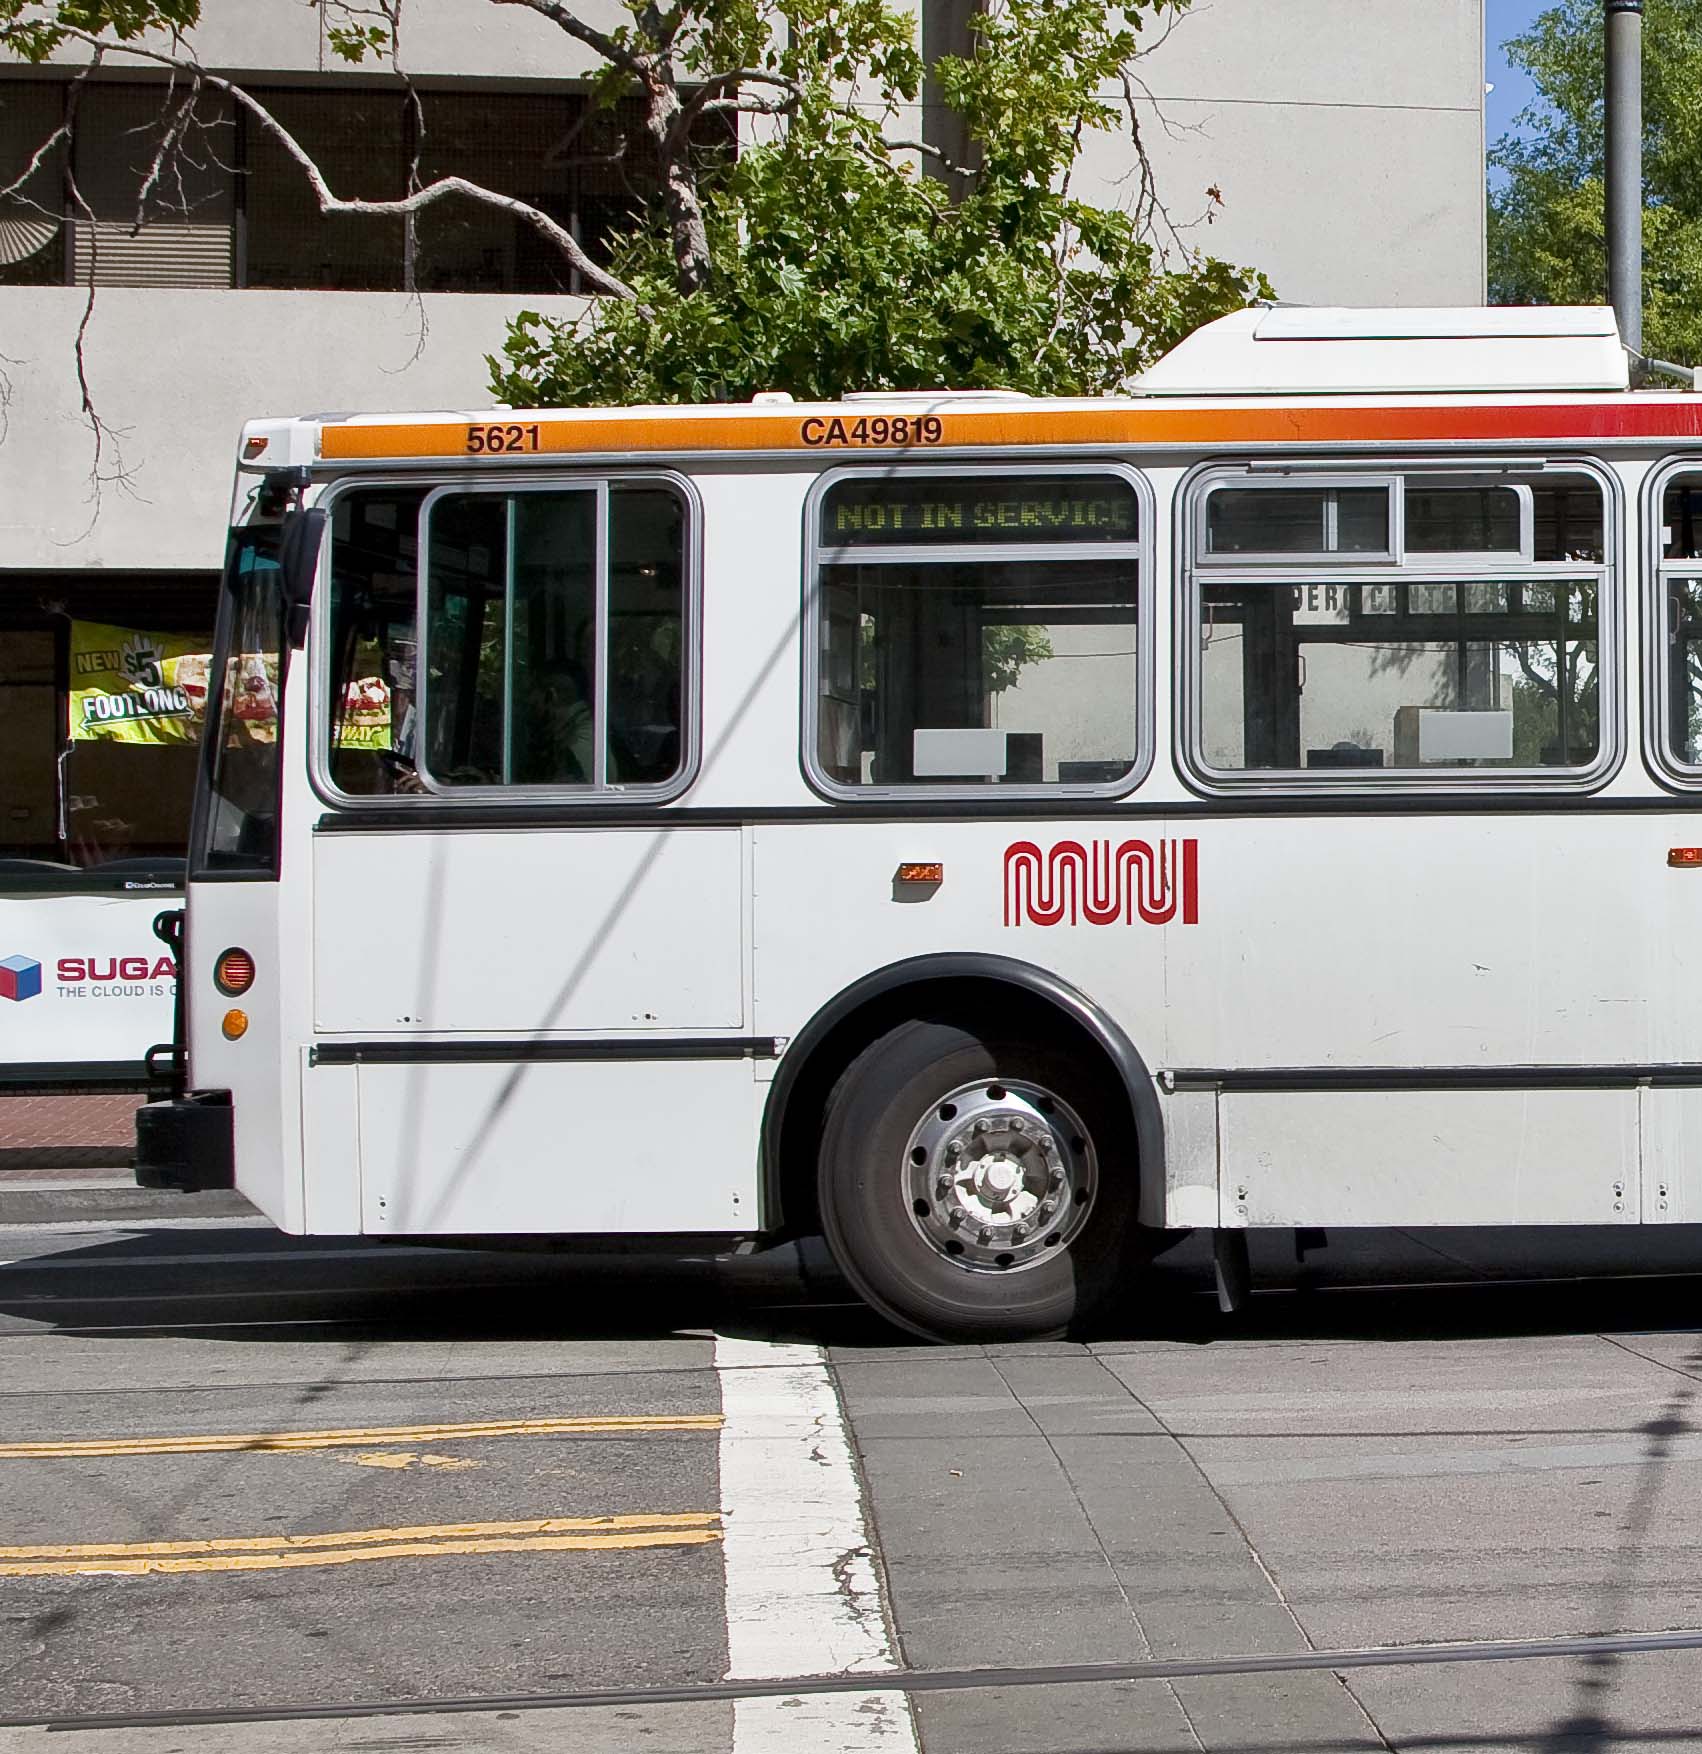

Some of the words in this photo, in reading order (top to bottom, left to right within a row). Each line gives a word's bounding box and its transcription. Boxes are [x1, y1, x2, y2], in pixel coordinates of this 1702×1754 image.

[466, 425, 540, 452] 5621
[801, 417, 943, 445] CA49819
[837, 503, 909, 529] NOT
[920, 503, 963, 528] IN
[76, 651, 121, 672] NEW
[124, 650, 161, 688] $5
[83, 687, 187, 719] FOOTLONG
[57, 986, 87, 998] THE
[91, 985, 145, 998] CLOUD
[150, 985, 164, 997] IS
